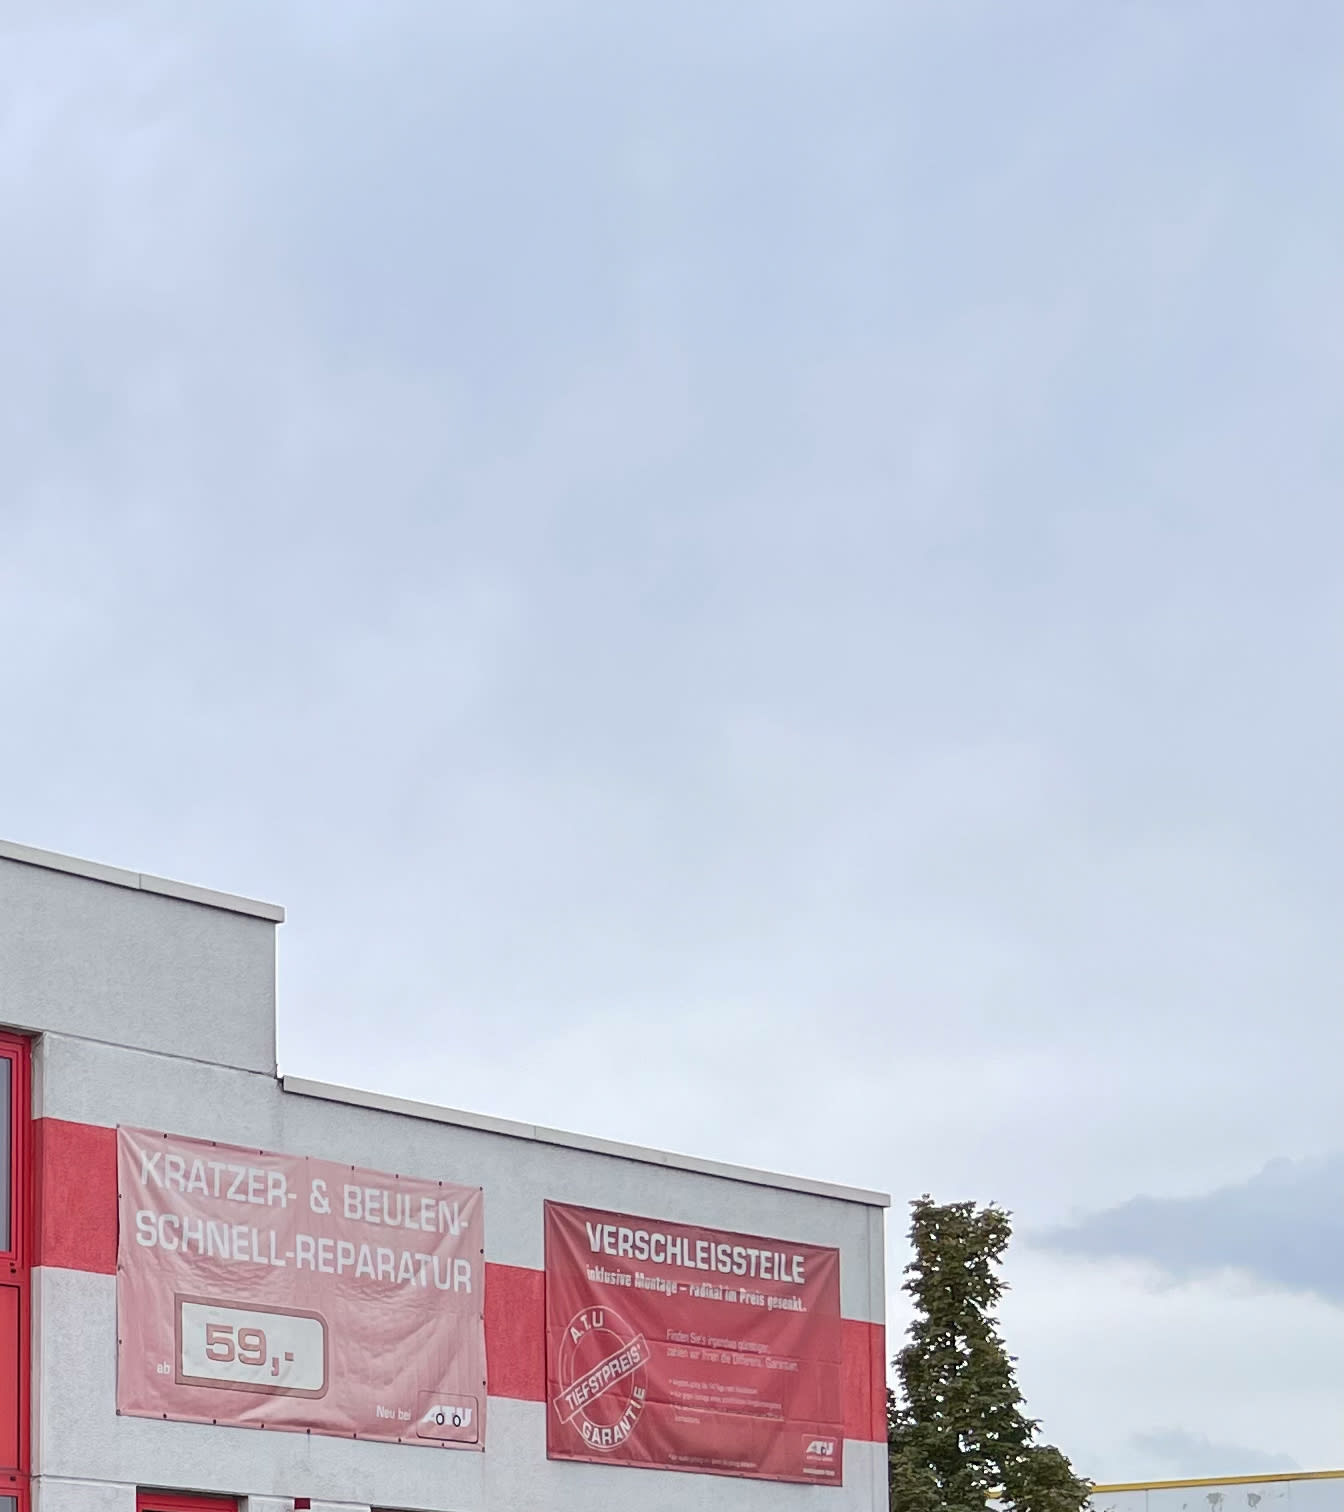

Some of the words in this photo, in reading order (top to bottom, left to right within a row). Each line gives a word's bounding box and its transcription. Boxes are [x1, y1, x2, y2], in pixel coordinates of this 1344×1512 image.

[141, 1151, 297, 1208] KRATZER-
[310, 1179, 332, 1214] &
[343, 1185, 468, 1236] BEULEN-
[136, 1210, 472, 1293] SCHNELL-REPARATUR
[585, 1221, 806, 1284] VERSCHLEISSTEILE
[586, 1264, 632, 1287] inklusive
[634, 1272, 678, 1296] Montage
[739, 1288, 765, 1307] Preis
[767, 1296, 808, 1312] gesenkt.
[156, 1361, 170, 1375] ab
[205, 1322, 295, 1377] 59,-
[376, 1405, 395, 1419] Neu
[397, 1407, 411, 1421] bei
[582, 1386, 646, 1445] GARANTIE
